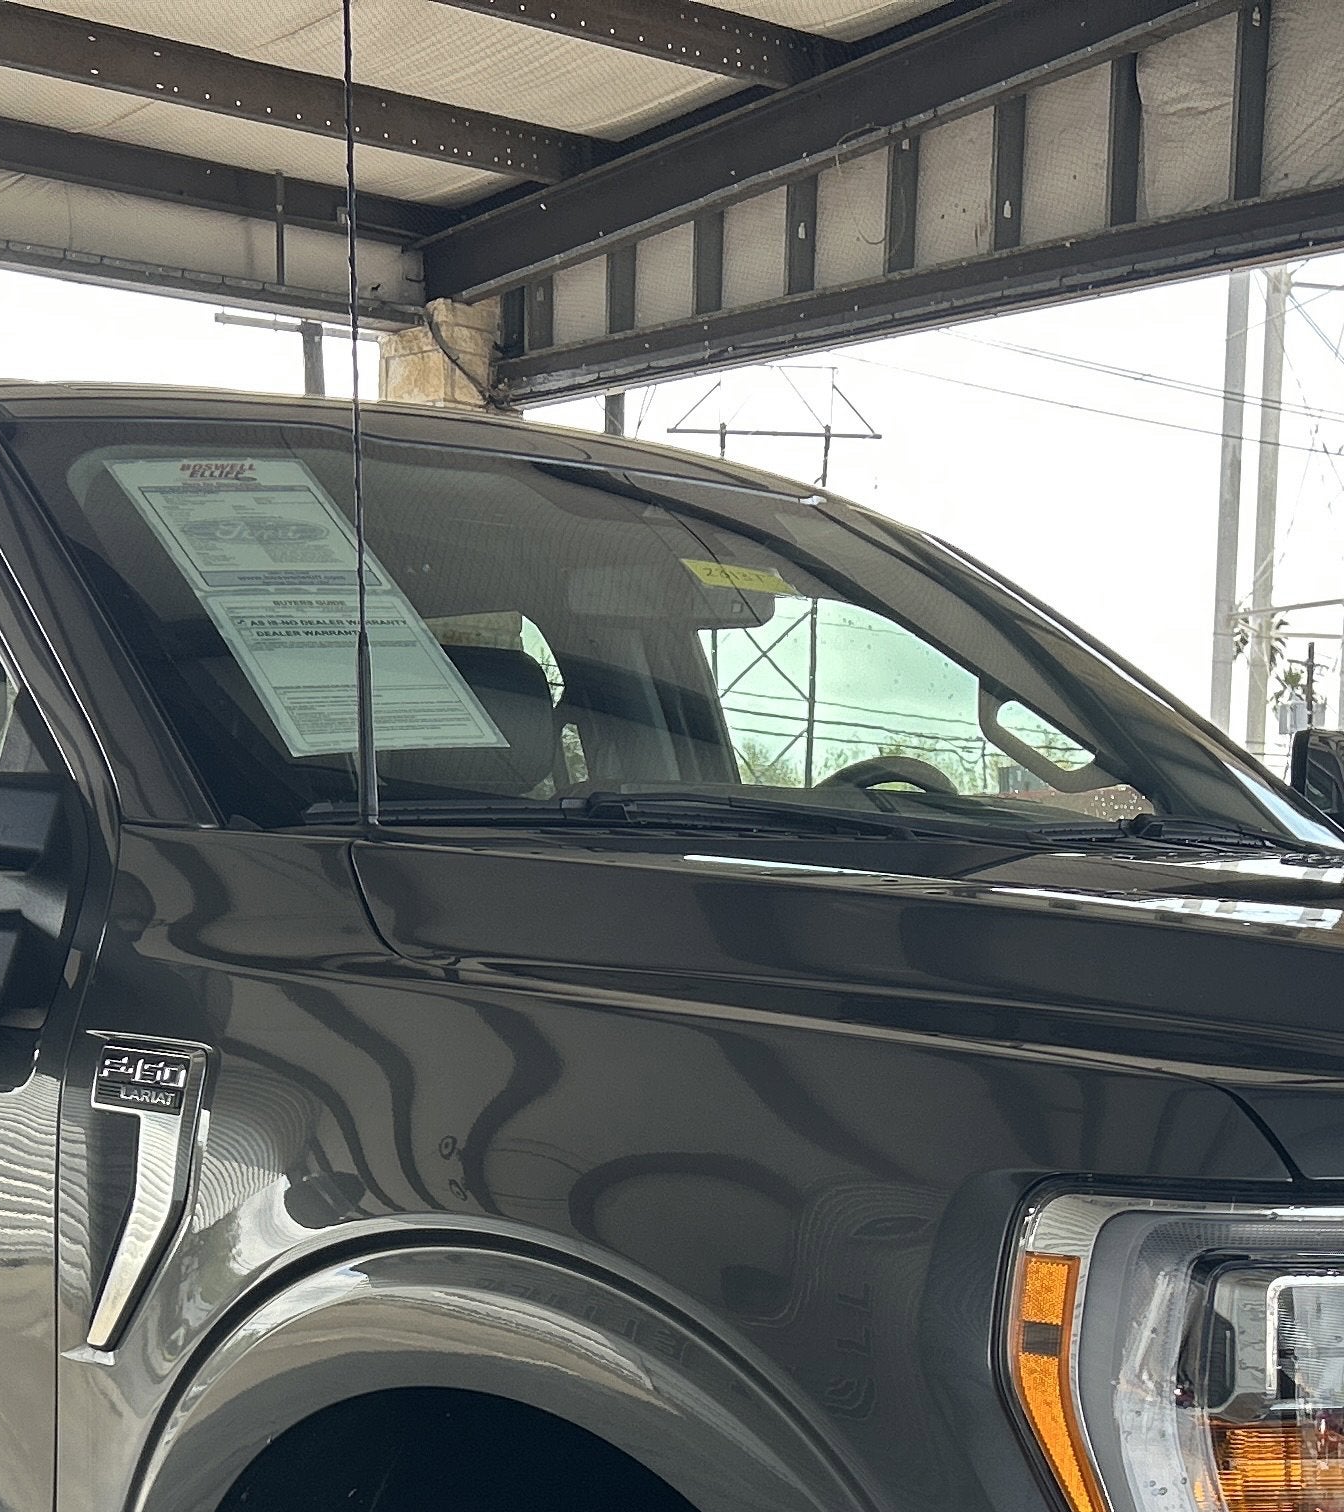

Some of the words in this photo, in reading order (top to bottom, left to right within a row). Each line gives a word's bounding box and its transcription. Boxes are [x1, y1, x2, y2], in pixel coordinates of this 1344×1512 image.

[179, 463, 257, 472] BOSWELL
[250, 619, 266, 627] AS
[300, 619, 345, 627] DEALER
[256, 629, 301, 638] DEALER
[98, 1056, 187, 1088] F-150
[119, 1085, 176, 1106] LARIAT
